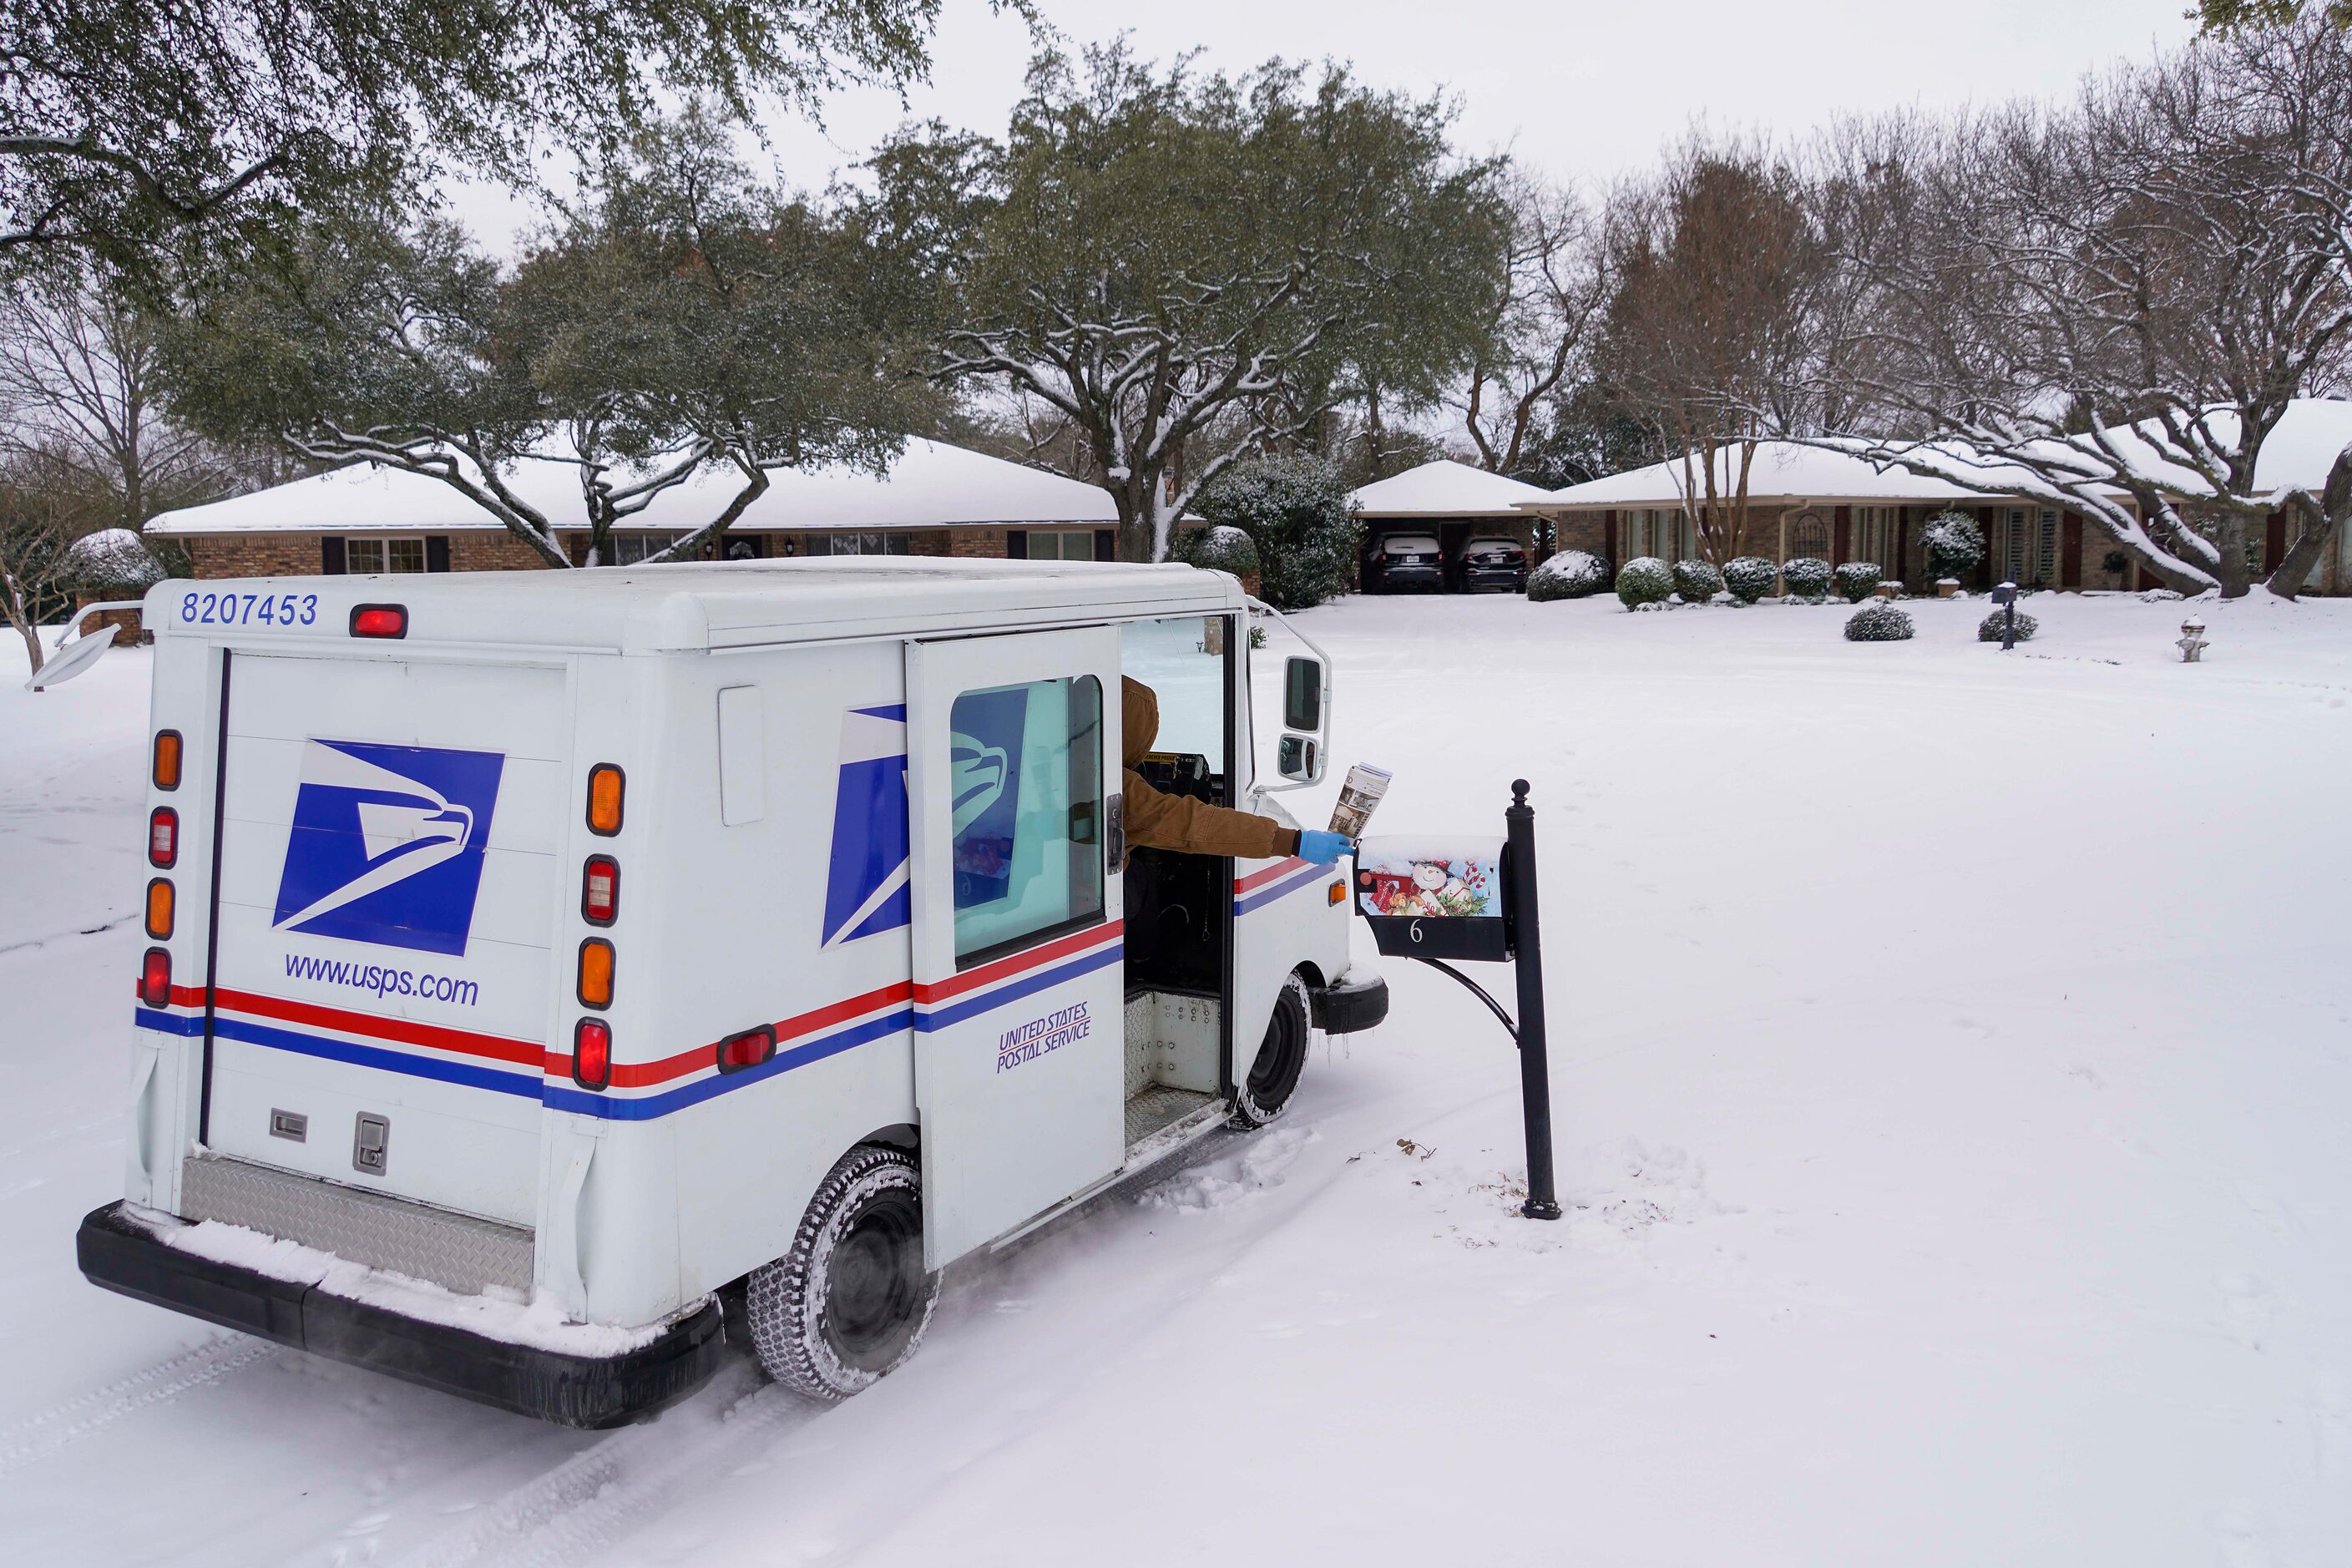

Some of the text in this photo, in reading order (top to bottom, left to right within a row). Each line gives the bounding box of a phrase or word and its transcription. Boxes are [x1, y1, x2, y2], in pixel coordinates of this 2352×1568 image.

[181, 592, 318, 625] 8207453
[1409, 918, 1423, 943] 6
[286, 953, 479, 1006] www.usps.com
[997, 1019, 1091, 1075] POSTAL SERVICE
[999, 1001, 1088, 1051] UNITED STATES
